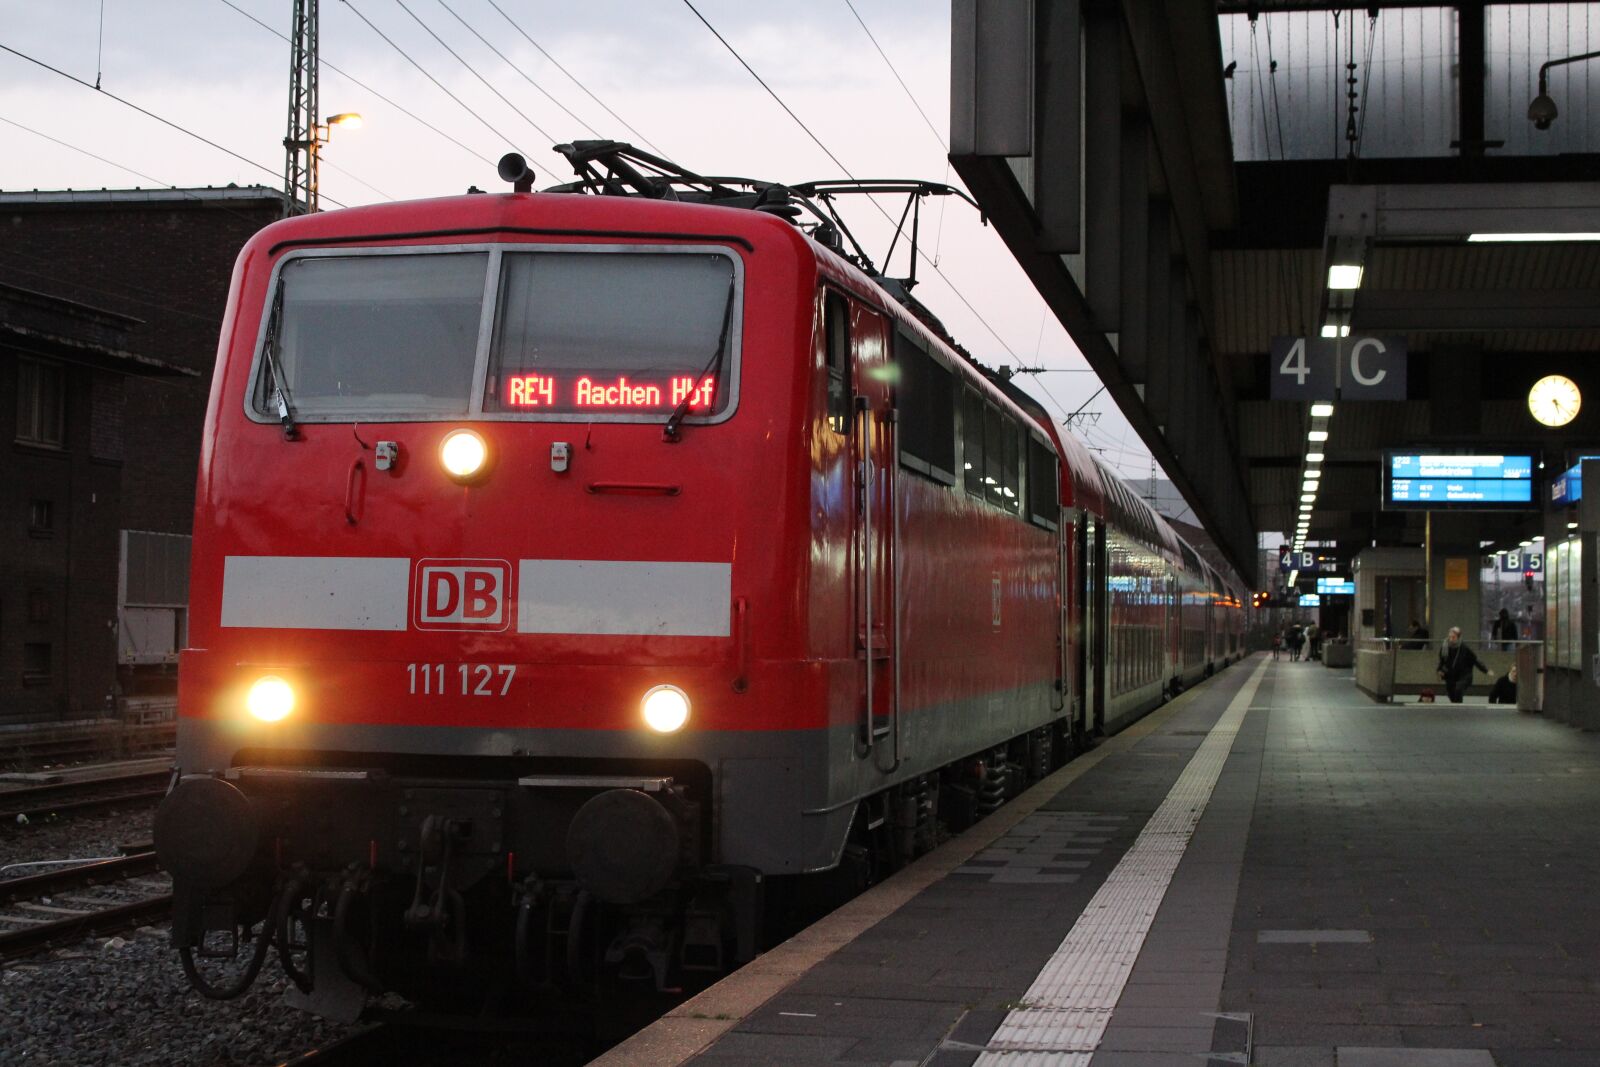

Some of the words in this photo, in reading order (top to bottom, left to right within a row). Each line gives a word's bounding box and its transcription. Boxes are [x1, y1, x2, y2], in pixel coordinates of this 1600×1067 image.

[1279, 338, 1311, 385] 4
[1350, 338, 1387, 386] C
[510, 376, 553, 405] RE4
[577, 376, 660, 405] Aachen
[1282, 551, 1292, 567] 4
[1302, 552, 1314, 567] B
[1507, 554, 1519, 569] B
[1530, 554, 1541, 569] 5
[426, 571, 498, 619] DB
[407, 663, 445, 695] 111
[458, 664, 516, 696] 127
